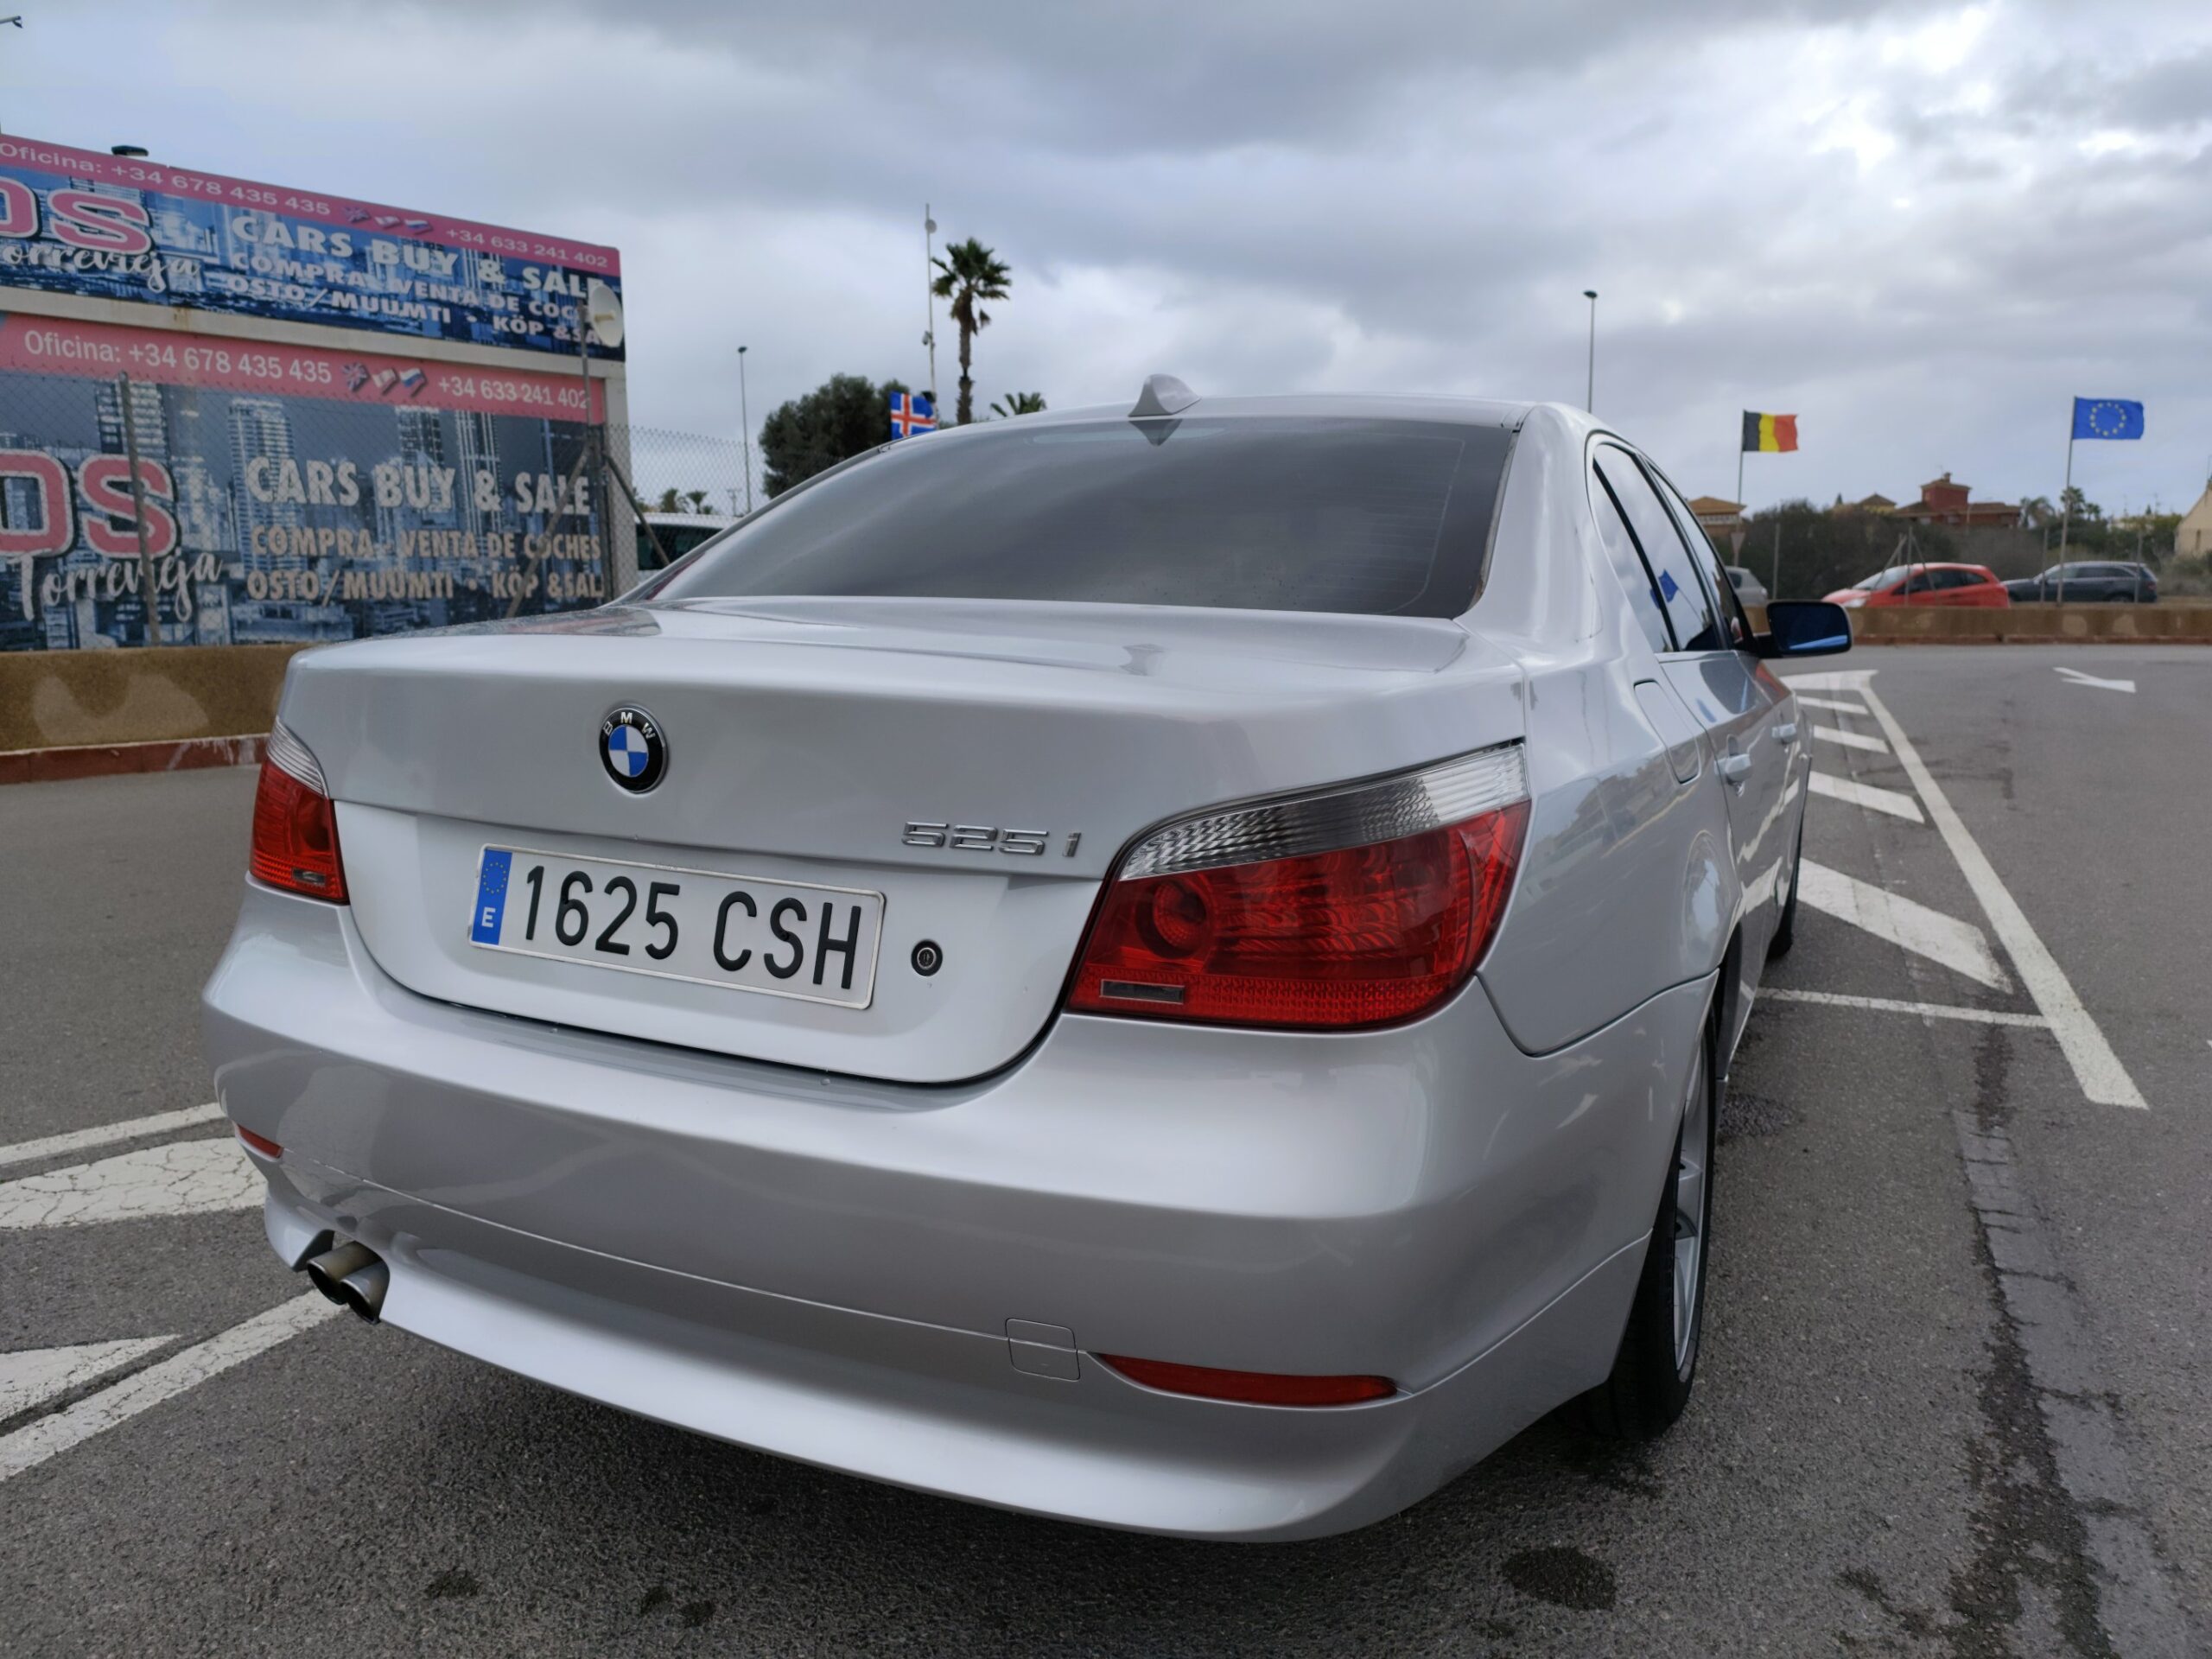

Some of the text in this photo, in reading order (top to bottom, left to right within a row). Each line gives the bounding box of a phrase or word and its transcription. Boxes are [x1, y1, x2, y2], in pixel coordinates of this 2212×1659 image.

[0, 143, 330, 215] Oficina: +34 678 435 435
[2, 245, 200, 293] orrevieja
[232, 217, 353, 257] CARS
[372, 238, 458, 275] BUY
[478, 259, 505, 284] &
[446, 228, 608, 268] +34 633 241 402
[232, 252, 365, 287] COMPRA
[391, 278, 478, 305] VENTA
[487, 294, 519, 312] DE
[493, 314, 544, 335] KÖP
[24, 330, 332, 385] Oficina: +34 678 435 435
[438, 376, 590, 410] +34 633 241 402
[245, 456, 591, 516] CARS BUY & SALE
[251, 524, 601, 560] COMPRA VENTA DE COCHES
[492, 564, 539, 598] KÖP
[603, 711, 656, 739] BMW
[481, 906, 496, 928] E
[524, 865, 862, 989] 1625 CSH
